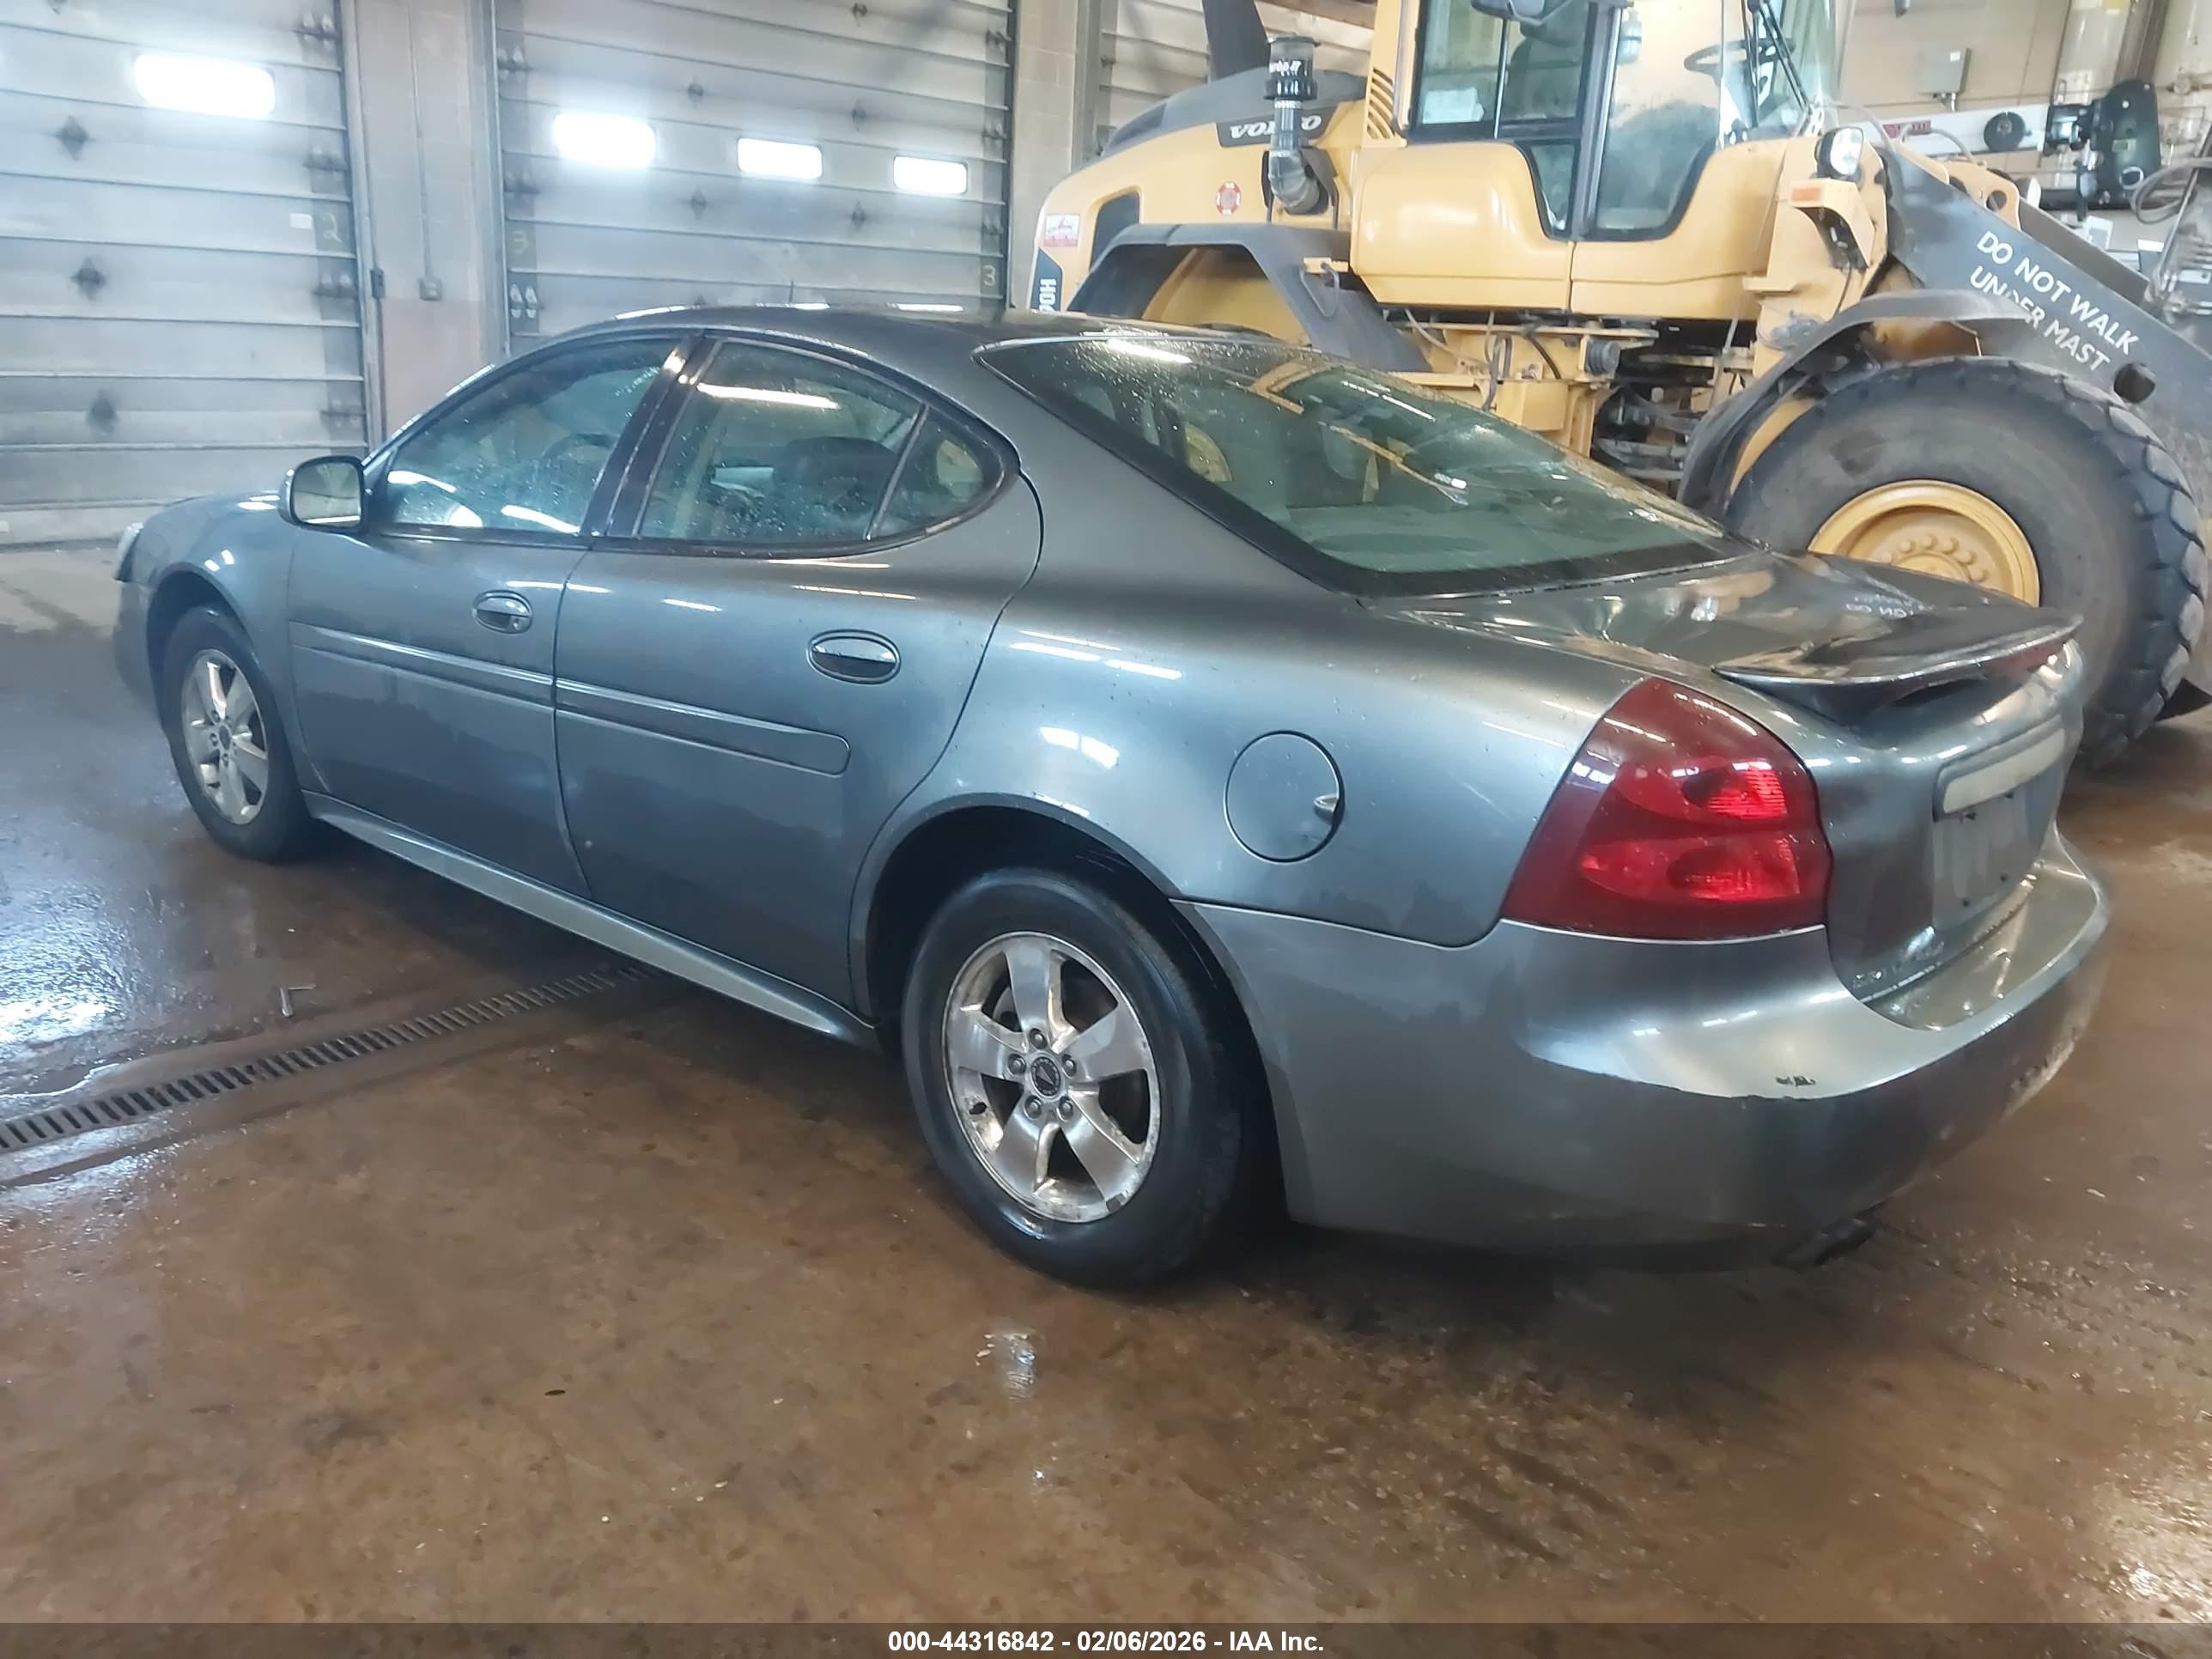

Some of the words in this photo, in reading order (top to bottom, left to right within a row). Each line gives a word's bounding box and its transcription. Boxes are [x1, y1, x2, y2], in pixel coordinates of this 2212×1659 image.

[1230, 115, 1322, 139] VOLO
[983, 264, 996, 287] 3
[1977, 231, 2014, 264] DO
[2014, 257, 2072, 303] NOT
[2069, 293, 2140, 356] WALK
[2043, 319, 2111, 372] MAST
